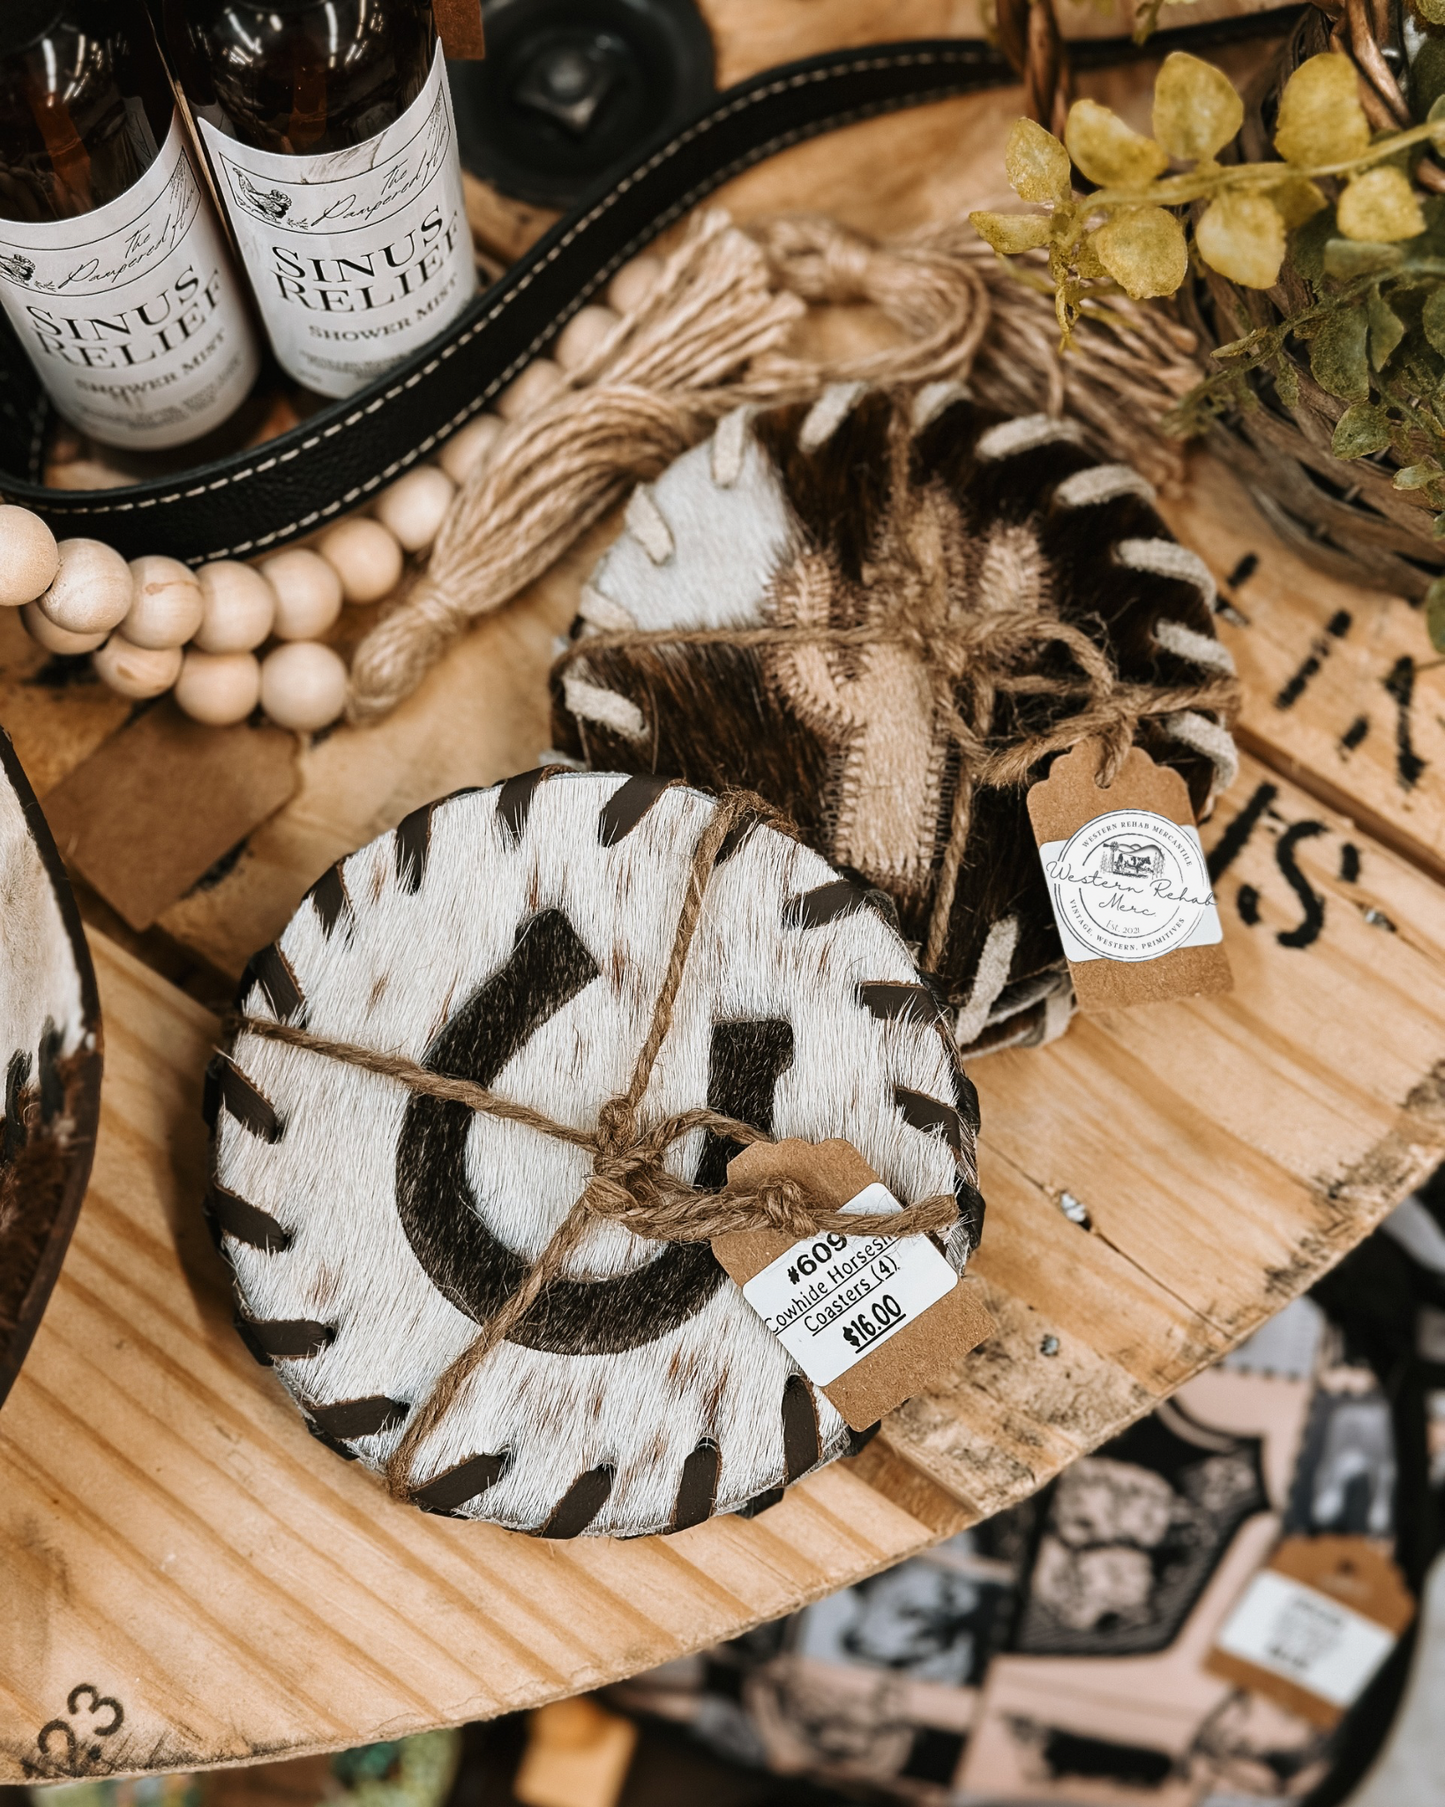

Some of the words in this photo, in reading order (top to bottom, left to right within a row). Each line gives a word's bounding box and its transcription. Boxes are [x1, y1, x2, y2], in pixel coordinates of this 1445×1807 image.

[271, 209, 458, 313] RELIEF
[272, 205, 444, 283] SINUS
[26, 265, 200, 342] SINUS
[32, 267, 221, 369] RELIEF
[308, 316, 412, 342] SHOWER
[415, 272, 458, 321] MIST
[74, 371, 178, 401] SHOWER
[182, 327, 227, 377] MIST
[1082, 823, 1118, 848] WESTERN
[1121, 820, 1150, 829] REHAB
[1153, 825, 1193, 867] MERCANTILE
[1046, 860, 1144, 894] Western
[1150, 878, 1218, 906] Rehab
[1122, 926, 1140, 934] 2021
[1141, 917, 1185, 950] PRIMITIVES
[787, 1232, 848, 1285] #609
[804, 1278, 871, 1333] Coasters
[870, 1255, 899, 1283] (4)
[842, 1294, 902, 1347] $16.00
